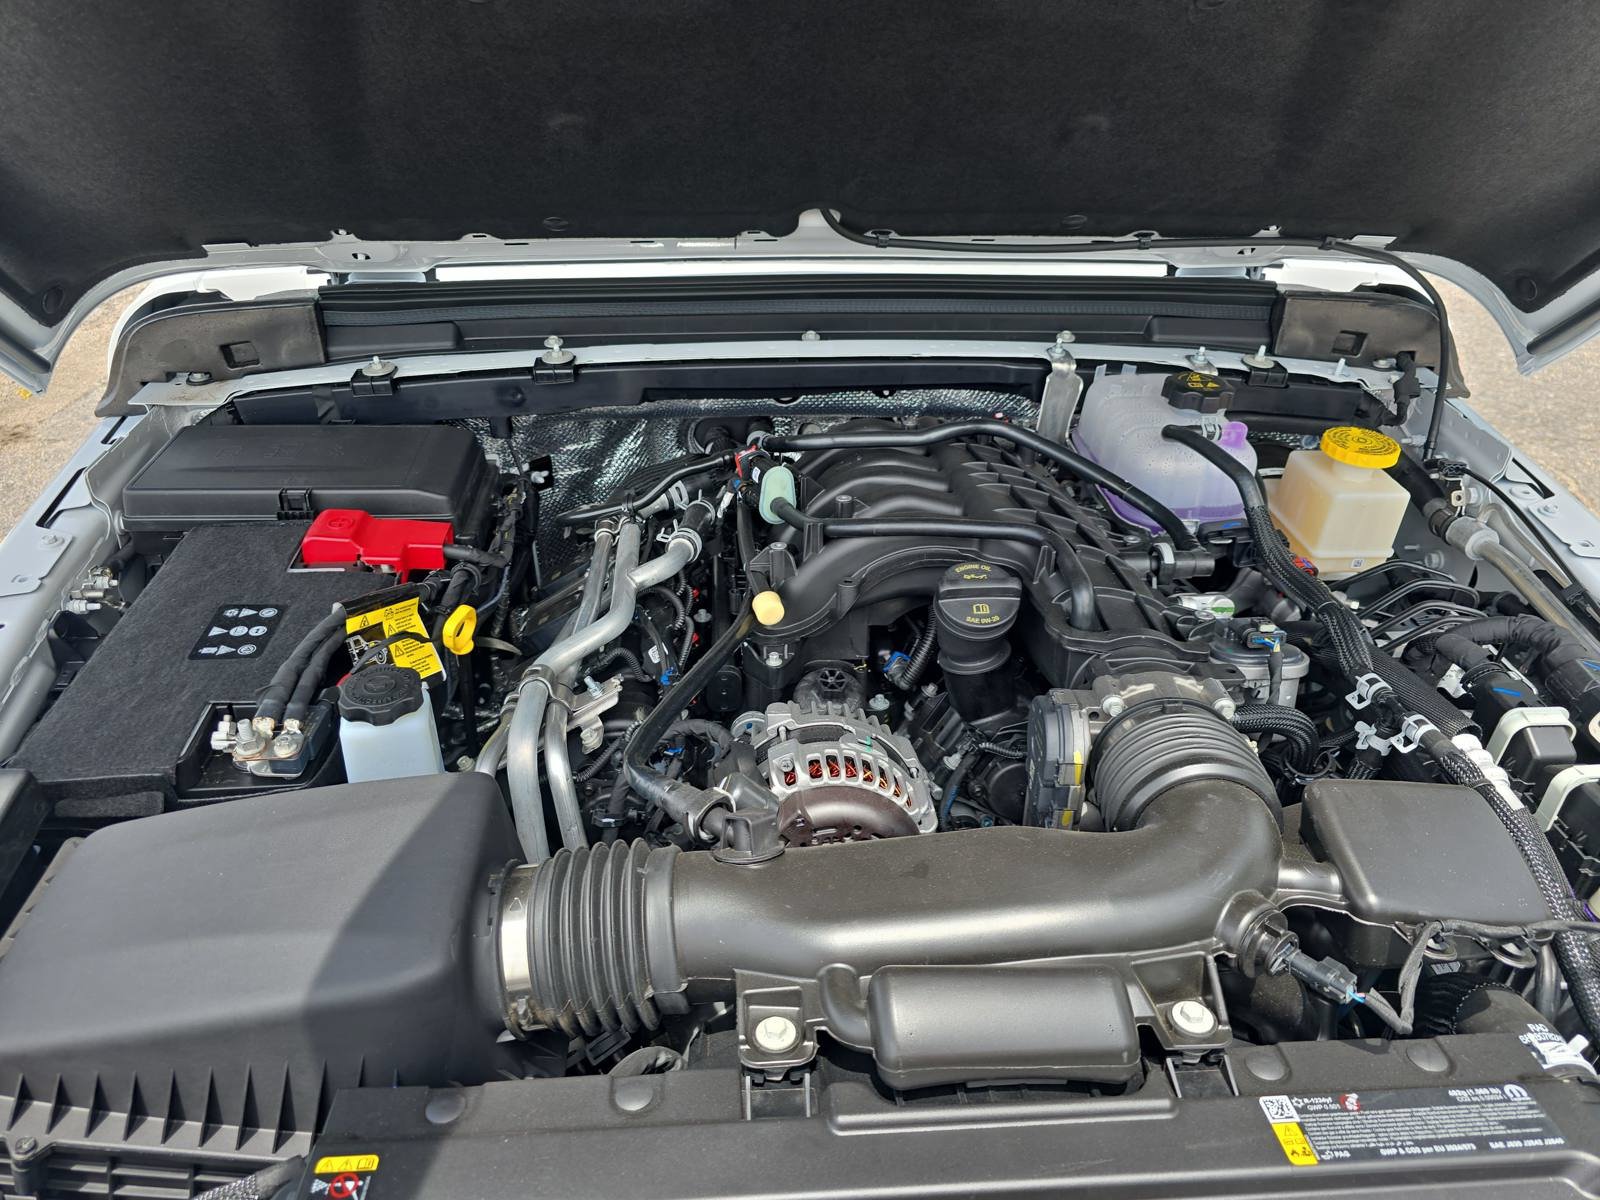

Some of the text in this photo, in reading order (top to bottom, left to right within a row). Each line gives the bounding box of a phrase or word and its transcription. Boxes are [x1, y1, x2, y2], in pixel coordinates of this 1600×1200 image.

[955, 564, 980, 572] ENGINE
[981, 616, 1000, 624] 0W-20
[1527, 1024, 1548, 1032] RAD
